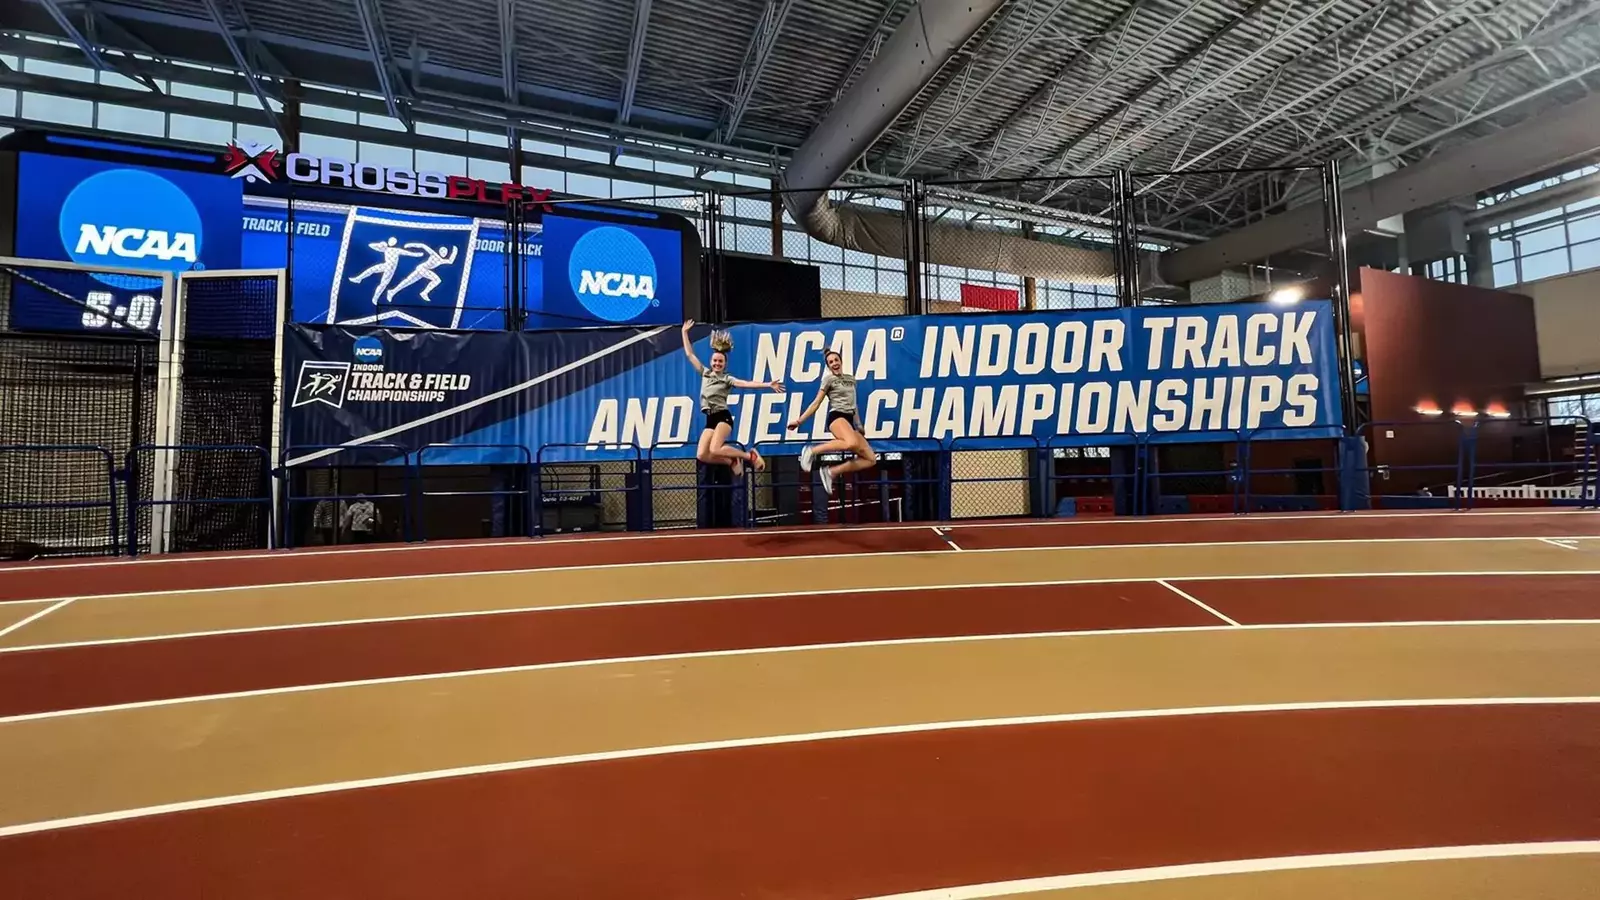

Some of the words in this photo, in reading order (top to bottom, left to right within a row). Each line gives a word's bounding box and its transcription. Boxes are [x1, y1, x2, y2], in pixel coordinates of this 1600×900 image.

[286, 152, 554, 213] CROSSPLEX
[242, 217, 283, 233] TRACK
[296, 222, 331, 237] FIELD
[75, 223, 197, 263] NCAA
[578, 269, 655, 300] NCAA
[82, 291, 163, 330] 5:0
[355, 348, 382, 356] NCAA
[919, 318, 1126, 378] INDOOR
[1143, 311, 1318, 371] TRACK
[350, 372, 409, 389] TRACK
[409, 373, 423, 390] &
[424, 374, 471, 390] FIELD
[352, 363, 384, 372] INDOOR
[347, 389, 446, 402] CHAMPIONSHIPS
[585, 396, 694, 450] AND
[862, 373, 1319, 441] CHAMPIONSHIPS
